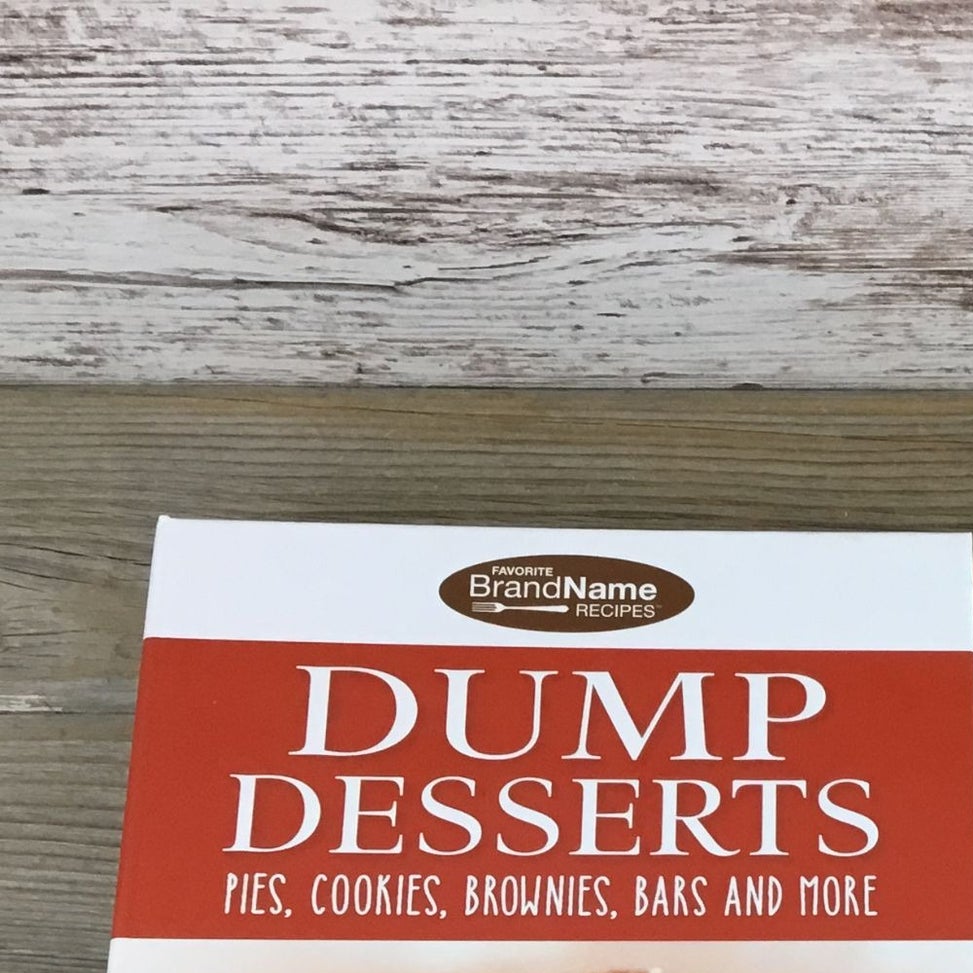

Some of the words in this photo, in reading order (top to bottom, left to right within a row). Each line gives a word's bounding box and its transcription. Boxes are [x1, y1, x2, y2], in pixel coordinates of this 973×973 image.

[469, 574, 658, 600] BrandName
[491, 566, 553, 577] FAVORITE
[575, 603, 655, 618] RECIPES
[288, 665, 827, 761] DUMP
[222, 773, 880, 858] DESSERTS
[222, 873, 292, 919] PIES,
[311, 873, 446, 920] COOKIES,
[464, 875, 618, 920] BROWNIES,
[635, 876, 707, 918] BARS
[724, 876, 783, 917] AND
[799, 875, 878, 917] MORE
